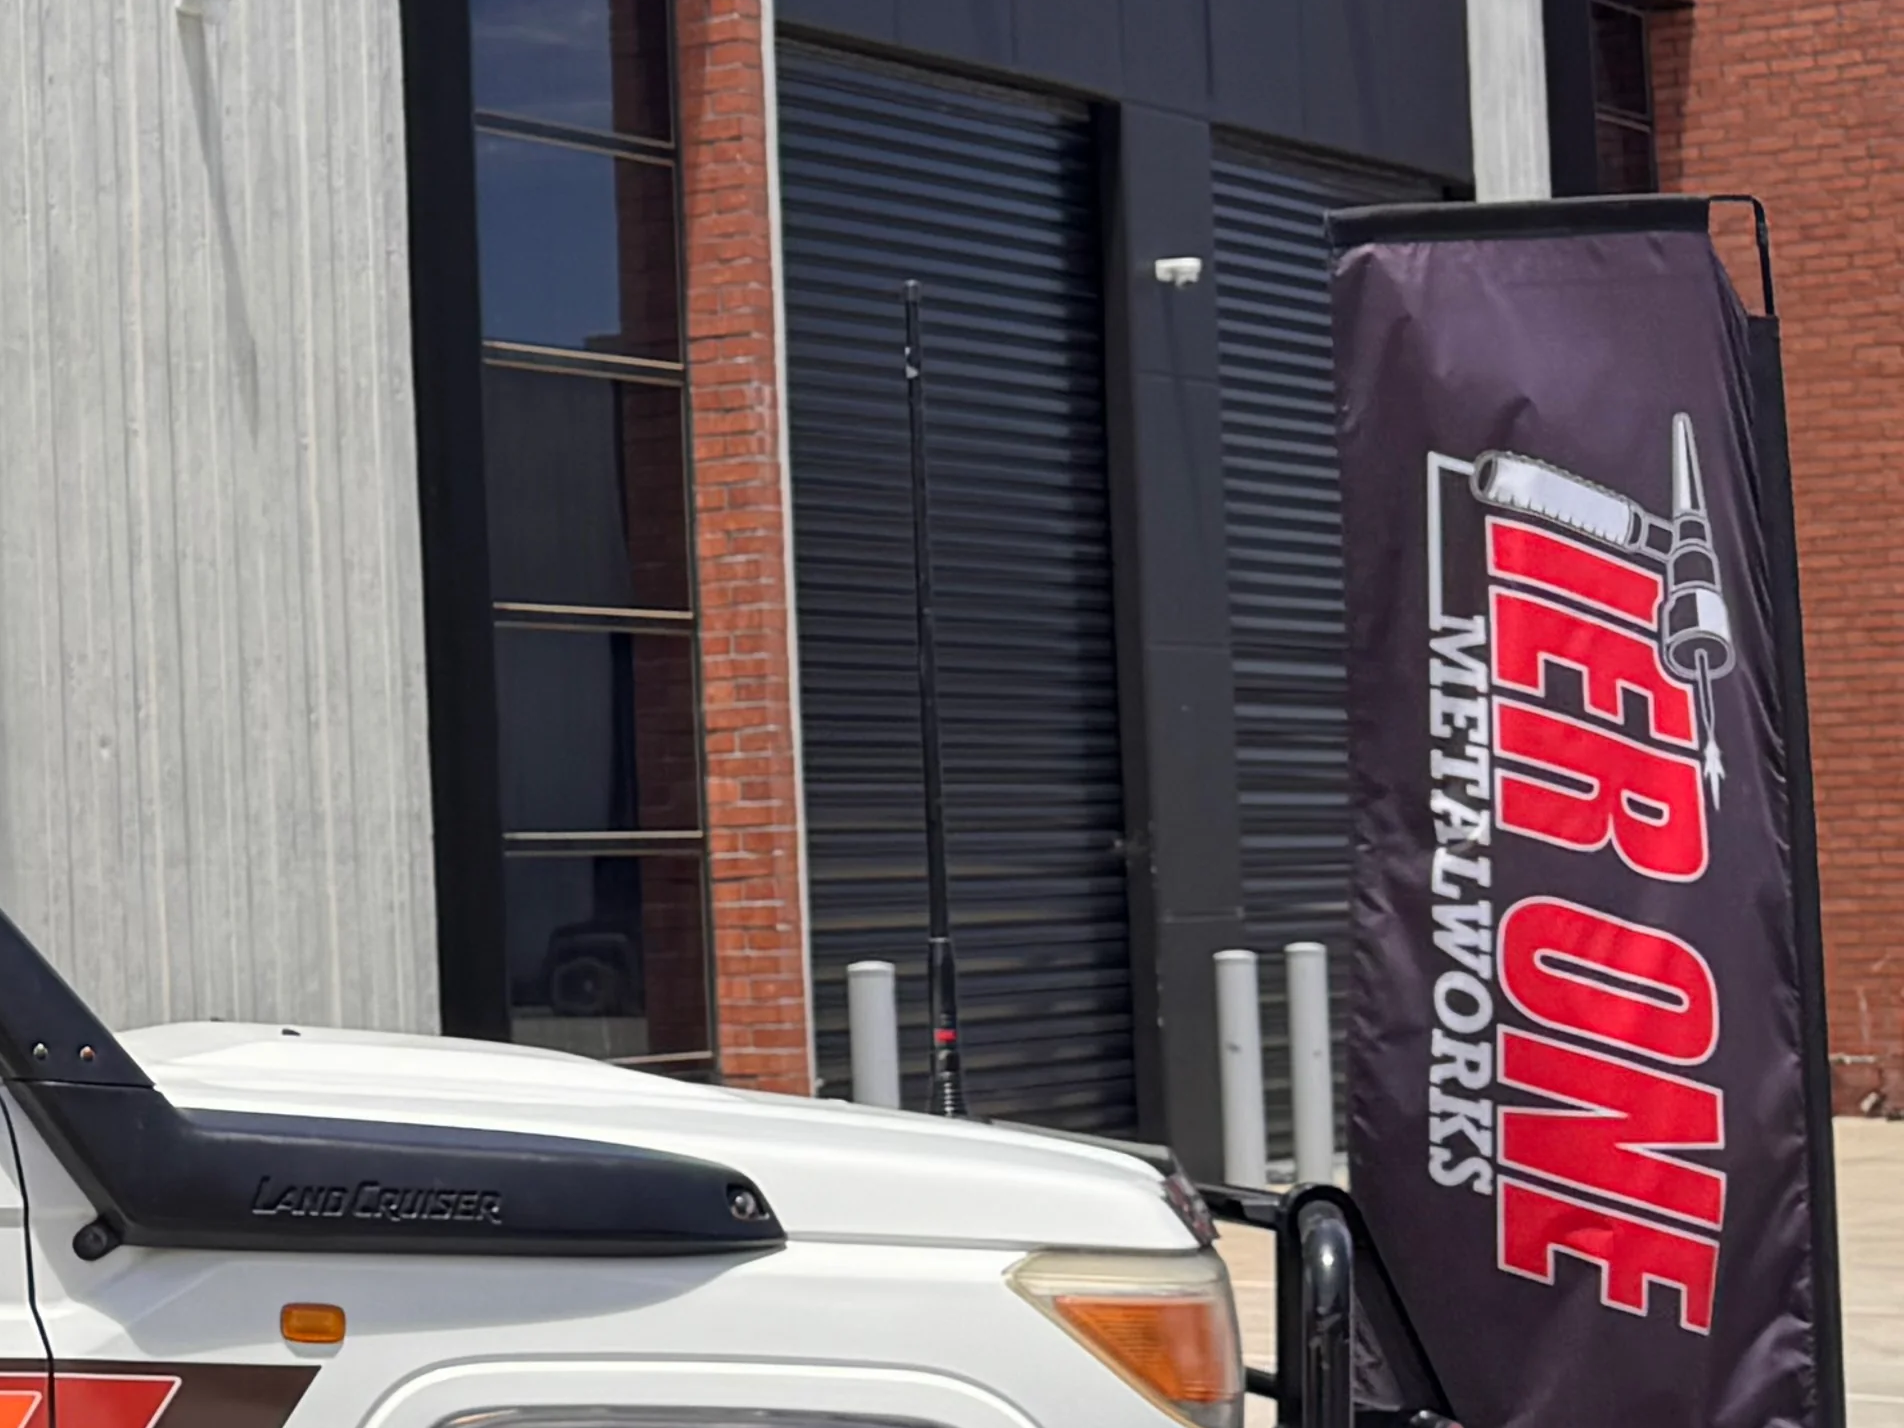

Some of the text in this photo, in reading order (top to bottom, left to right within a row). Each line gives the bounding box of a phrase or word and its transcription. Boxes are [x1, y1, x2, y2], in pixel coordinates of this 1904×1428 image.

[1428, 614, 1493, 1196] METALWORKS
[1496, 895, 1726, 1336] ONE
[352, 1180, 502, 1224] CRUISER
